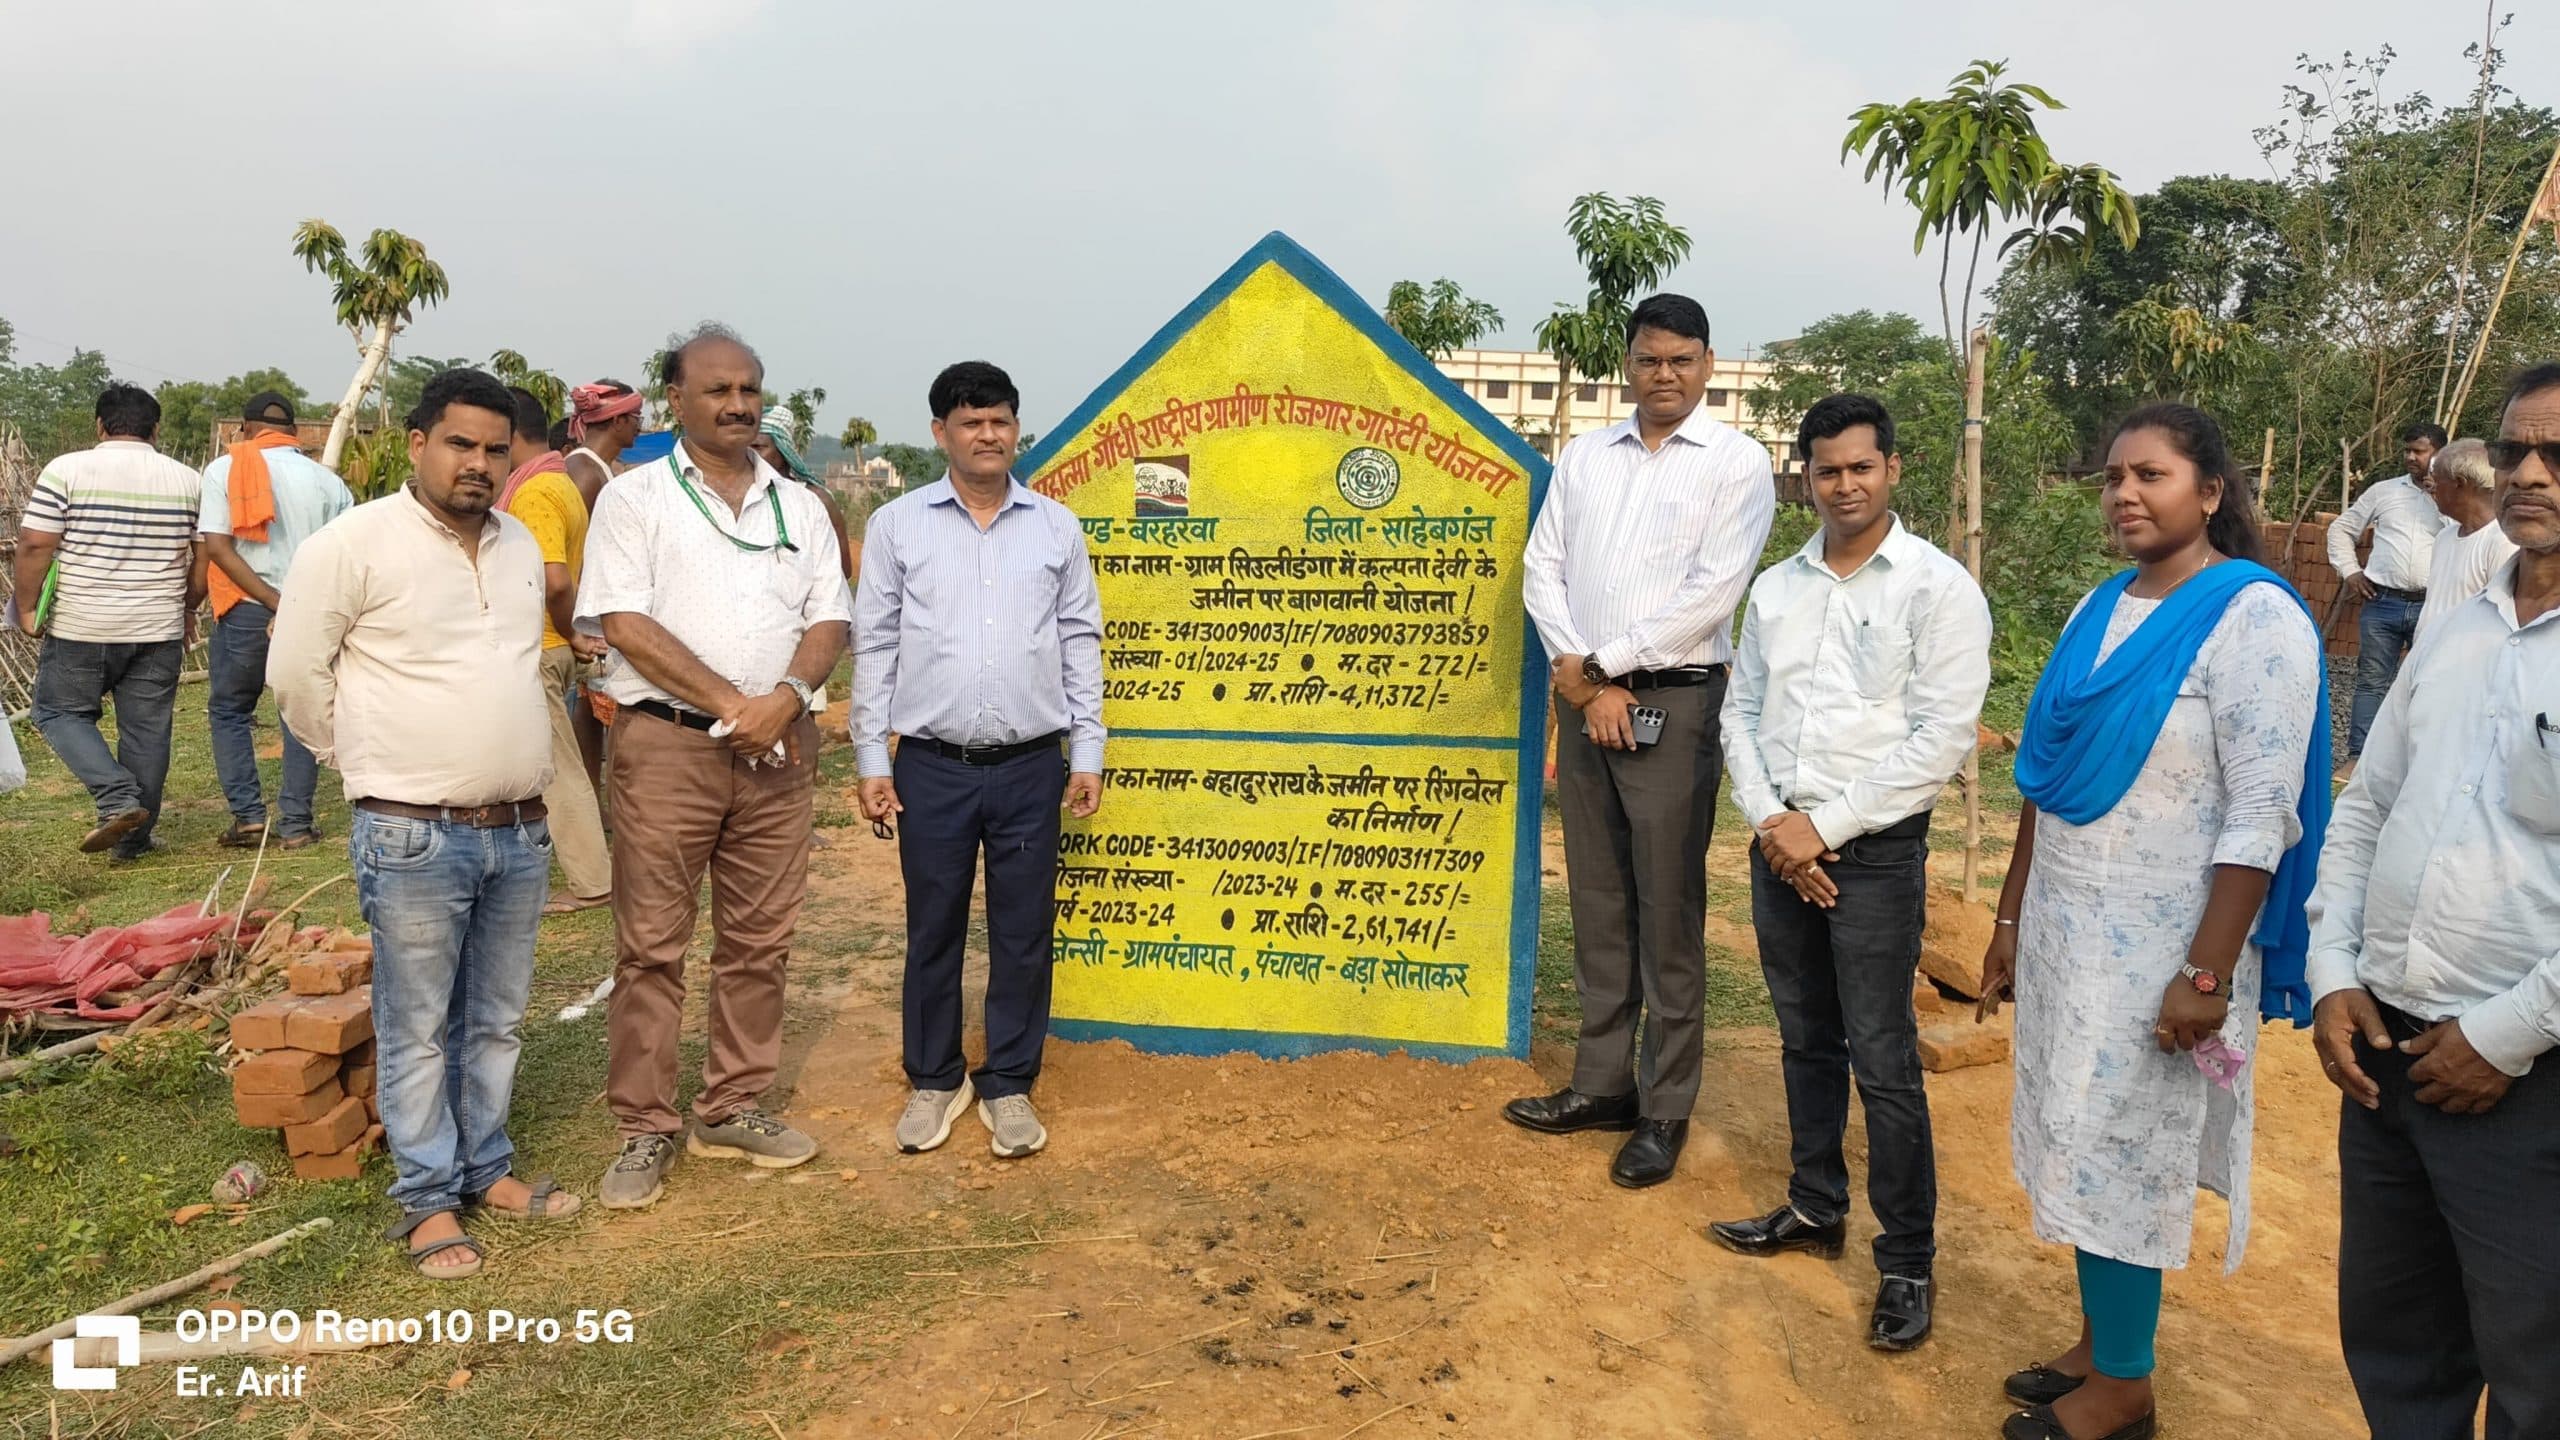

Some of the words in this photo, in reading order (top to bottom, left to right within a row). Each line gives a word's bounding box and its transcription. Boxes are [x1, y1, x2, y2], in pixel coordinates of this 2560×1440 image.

[1138, 397, 1202, 449] राष्ट्रीय
[1203, 383, 1271, 431] ग्रामीण
[1274, 384, 1355, 436] रोजगार
[1356, 406, 1429, 456] गारंटी
[1424, 431, 1519, 498] योजना
[1103, 554, 1131, 577] का
[1338, 549, 1357, 579] में
[1358, 556, 1431, 581] कल्पना
[1432, 548, 1472, 584] देवी
[1470, 548, 1497, 580] के
[1190, 579, 1255, 612] जमीन
[1256, 587, 1286, 613] पर
[1287, 580, 1379, 612] बागवानी
[1116, 767, 1148, 789] का
[1326, 764, 1391, 797] जमीन
[1393, 776, 1421, 802] पर
[1327, 807, 1364, 831] का
[1363, 801, 1443, 834] निर्माण
[1058, 832, 1103, 856] ORK
[1056, 858, 1110, 889] ोजना
